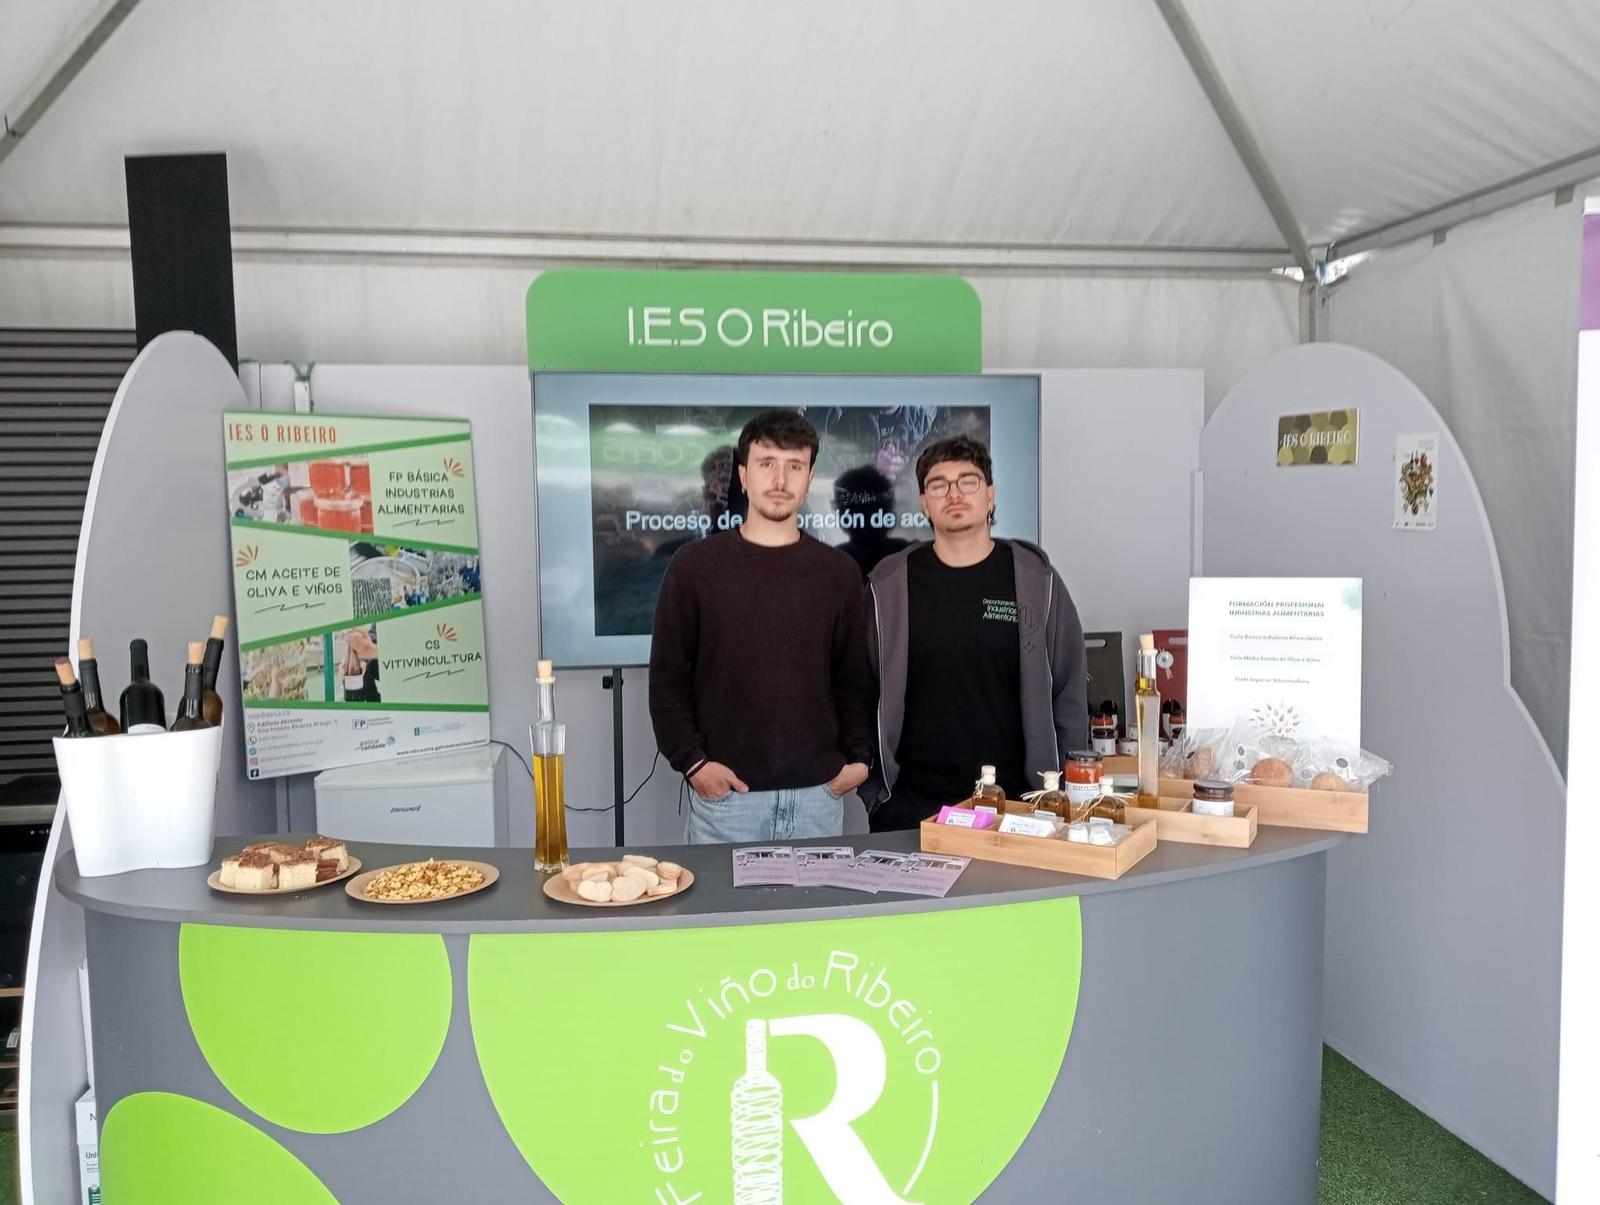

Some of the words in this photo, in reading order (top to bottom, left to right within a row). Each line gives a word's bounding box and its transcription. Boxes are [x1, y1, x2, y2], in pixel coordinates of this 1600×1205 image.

[628, 306, 706, 347] I.E.S
[717, 307, 753, 347] O
[763, 308, 894, 348] Ribeiro
[229, 423, 253, 441] IES
[261, 424, 269, 442] O
[277, 425, 336, 443] RIBEIRO
[1309, 429, 1351, 447] RIBEIRO
[389, 471, 403, 482] FP
[408, 469, 449, 483] BÁSICA
[385, 487, 455, 499] INDUSTRIAS
[377, 503, 465, 516] ALIMENTARIAS
[625, 510, 711, 531] Proceso
[717, 510, 743, 530] de
[870, 508, 896, 528] de
[246, 569, 267, 581] CM
[272, 567, 319, 580] ACEITE
[324, 566, 341, 578] DE
[247, 585, 287, 598] OLIVA
[292, 585, 300, 596] E
[305, 582, 343, 596] VIÑOS
[1229, 600, 1274, 608] FORMACIÓN
[425, 640, 440, 650] CS
[382, 651, 482, 670] VITIVINICULTURA
[786, 962, 816, 991] do
[665, 968, 778, 1039] Viño
[822, 950, 942, 1075] Ribeiro
[659, 1048, 693, 1084] do
